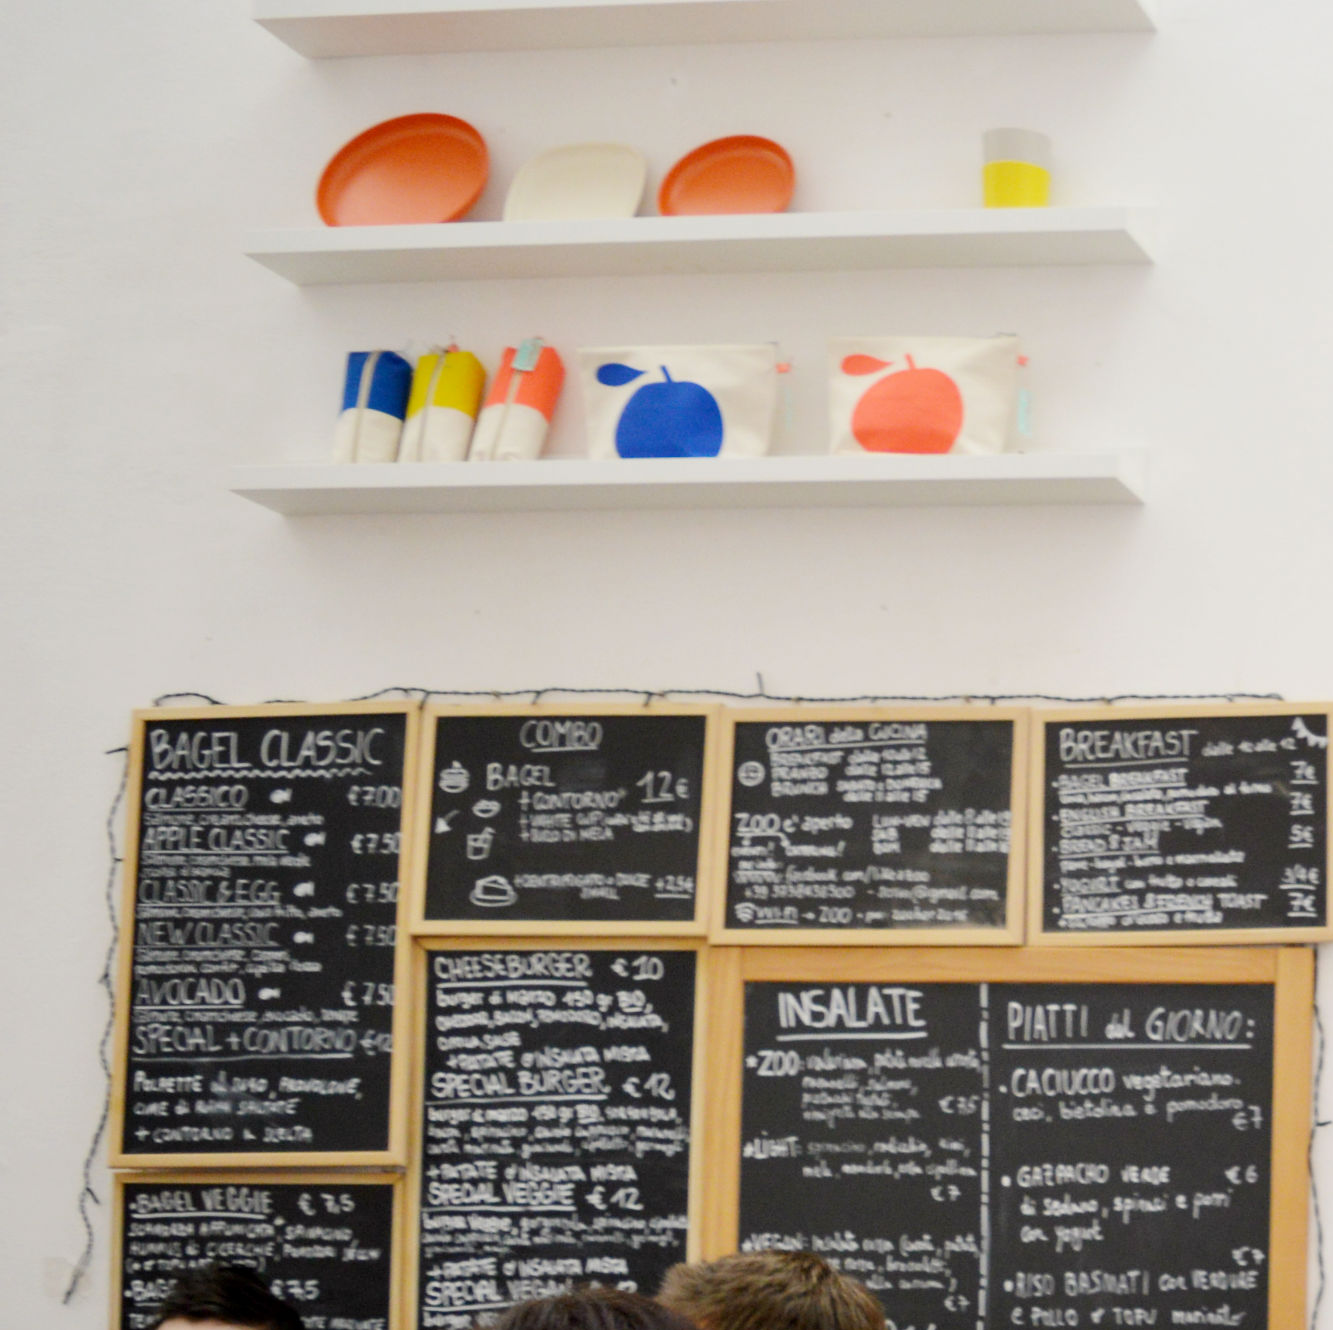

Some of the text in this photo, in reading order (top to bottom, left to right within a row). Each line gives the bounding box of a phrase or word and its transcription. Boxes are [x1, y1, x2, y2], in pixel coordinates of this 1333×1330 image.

[519, 720, 603, 748] COMBO
[1059, 727, 1199, 761] BREAKFAST
[150, 728, 384, 769] BAGEL CLASSIC
[486, 763, 556, 790] BAGEL
[145, 785, 248, 808] CLASSICO
[142, 827, 204, 850] APPLE
[208, 828, 290, 850] CLASSIC
[235, 879, 281, 902] EGG
[137, 922, 194, 946] NEW
[195, 922, 279, 946] CLASSIC
[135, 978, 246, 1005] AVOCADO
[778, 986, 927, 1028] INSALATE
[1008, 1002, 1088, 1041] PIATTI
[132, 1023, 222, 1054] SPECIAL
[243, 1025, 357, 1053] CONTORNO
[431, 1071, 516, 1099] SPECIAL
[517, 1066, 612, 1096] BURGER
[1011, 1067, 1115, 1097] CACIUCCO
[1017, 1162, 1110, 1187] GAZPACHO
[200, 1186, 273, 1214] VEGGIE
[428, 1182, 502, 1206] SPECIAL
[503, 1182, 577, 1206] VEGGIE
[425, 1280, 504, 1306] SPECIAL
[1016, 1271, 1055, 1298] RISO
[1064, 1270, 1149, 1296] BASMATI
[1191, 1269, 1258, 1291] VERDURE
[1031, 1307, 1079, 1327] POLLO
[1112, 1307, 1157, 1326] TOFU
